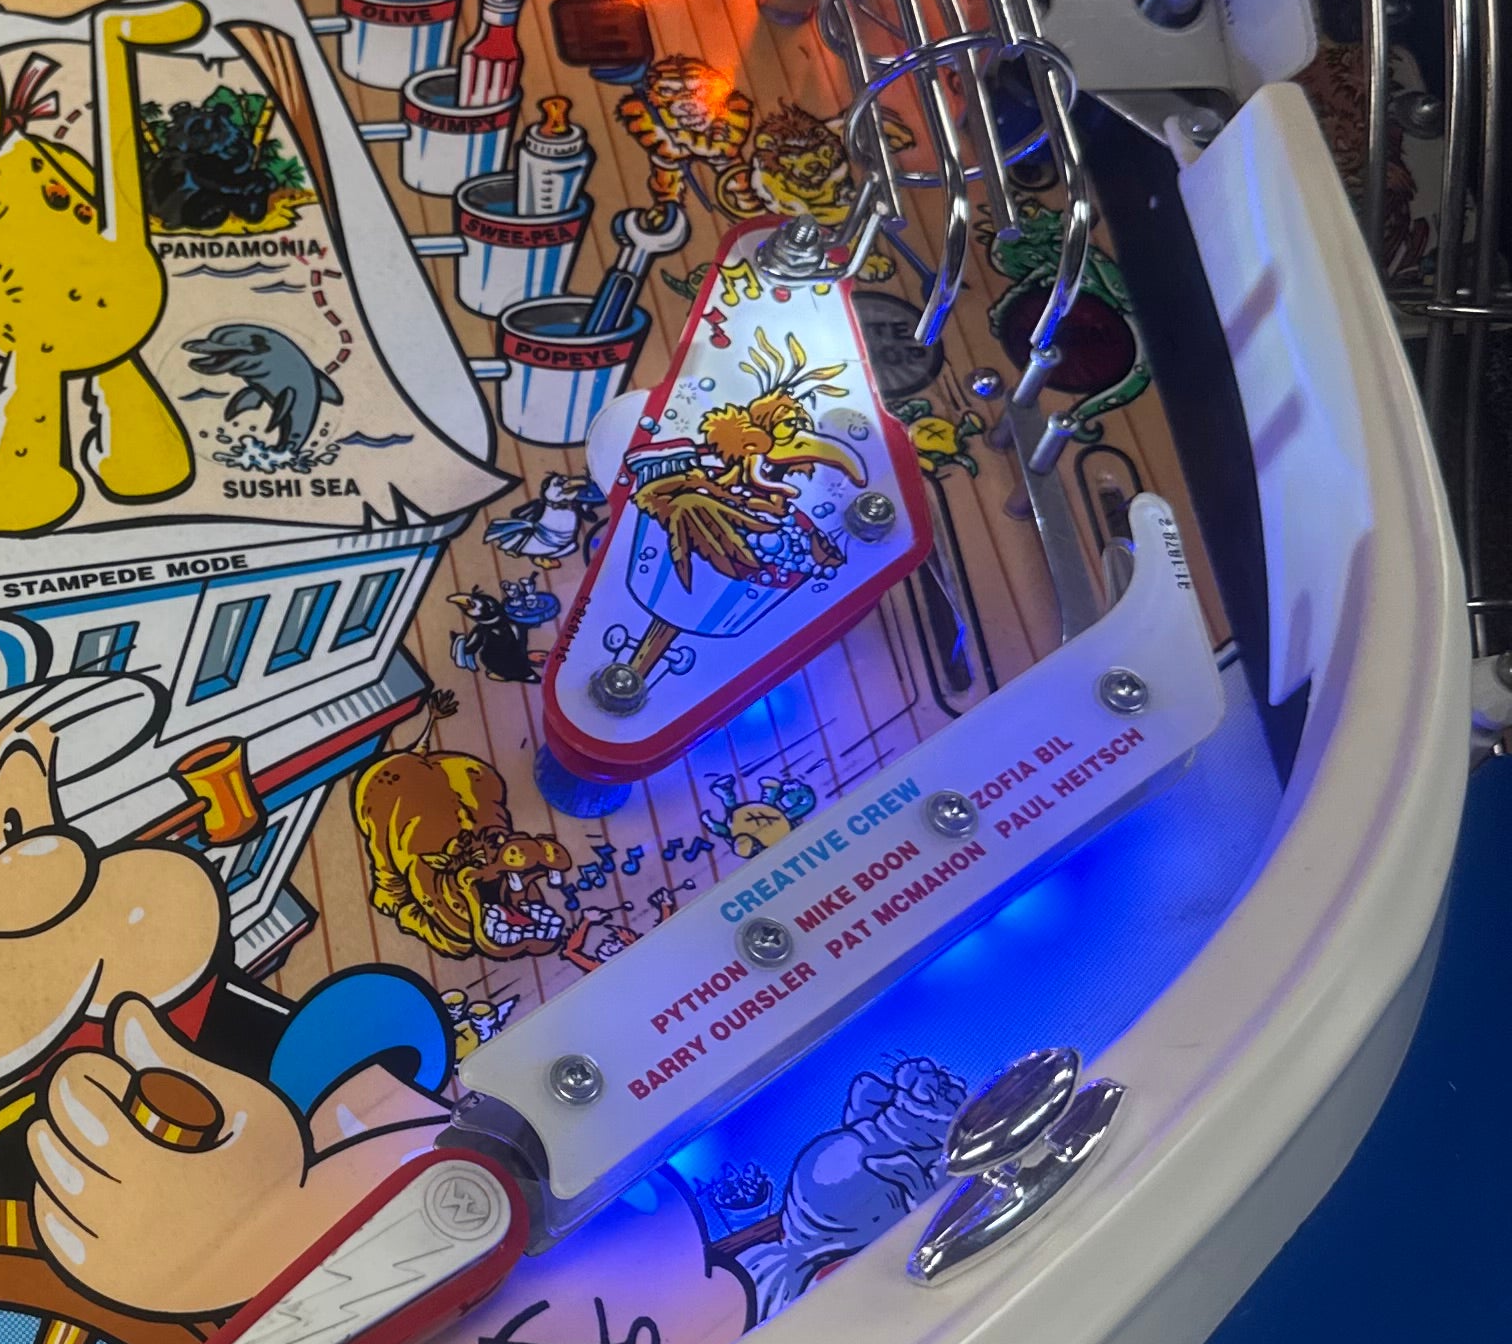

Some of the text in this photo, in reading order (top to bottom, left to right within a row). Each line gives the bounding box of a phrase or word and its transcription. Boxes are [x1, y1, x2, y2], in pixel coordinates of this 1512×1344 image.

[360, 4, 435, 24] OLIVE
[415, 112, 498, 135] WIMPY
[463, 219, 578, 246] SWEE-PEA
[158, 238, 323, 260] PANDAMONIA
[513, 340, 622, 368] POPEYE
[223, 477, 362, 500] SUSHI SEA
[1, 564, 155, 600] STAMPEDE
[166, 554, 250, 579] MODE
[719, 776, 922, 924] CREATIVE CREW
[649, 735, 1075, 1035] PYTHON MIKE BOON ZOFIA BIL
[626, 726, 1146, 1101] BARRY OURSLER PAT MCMAHON PAUL HEITSCH
